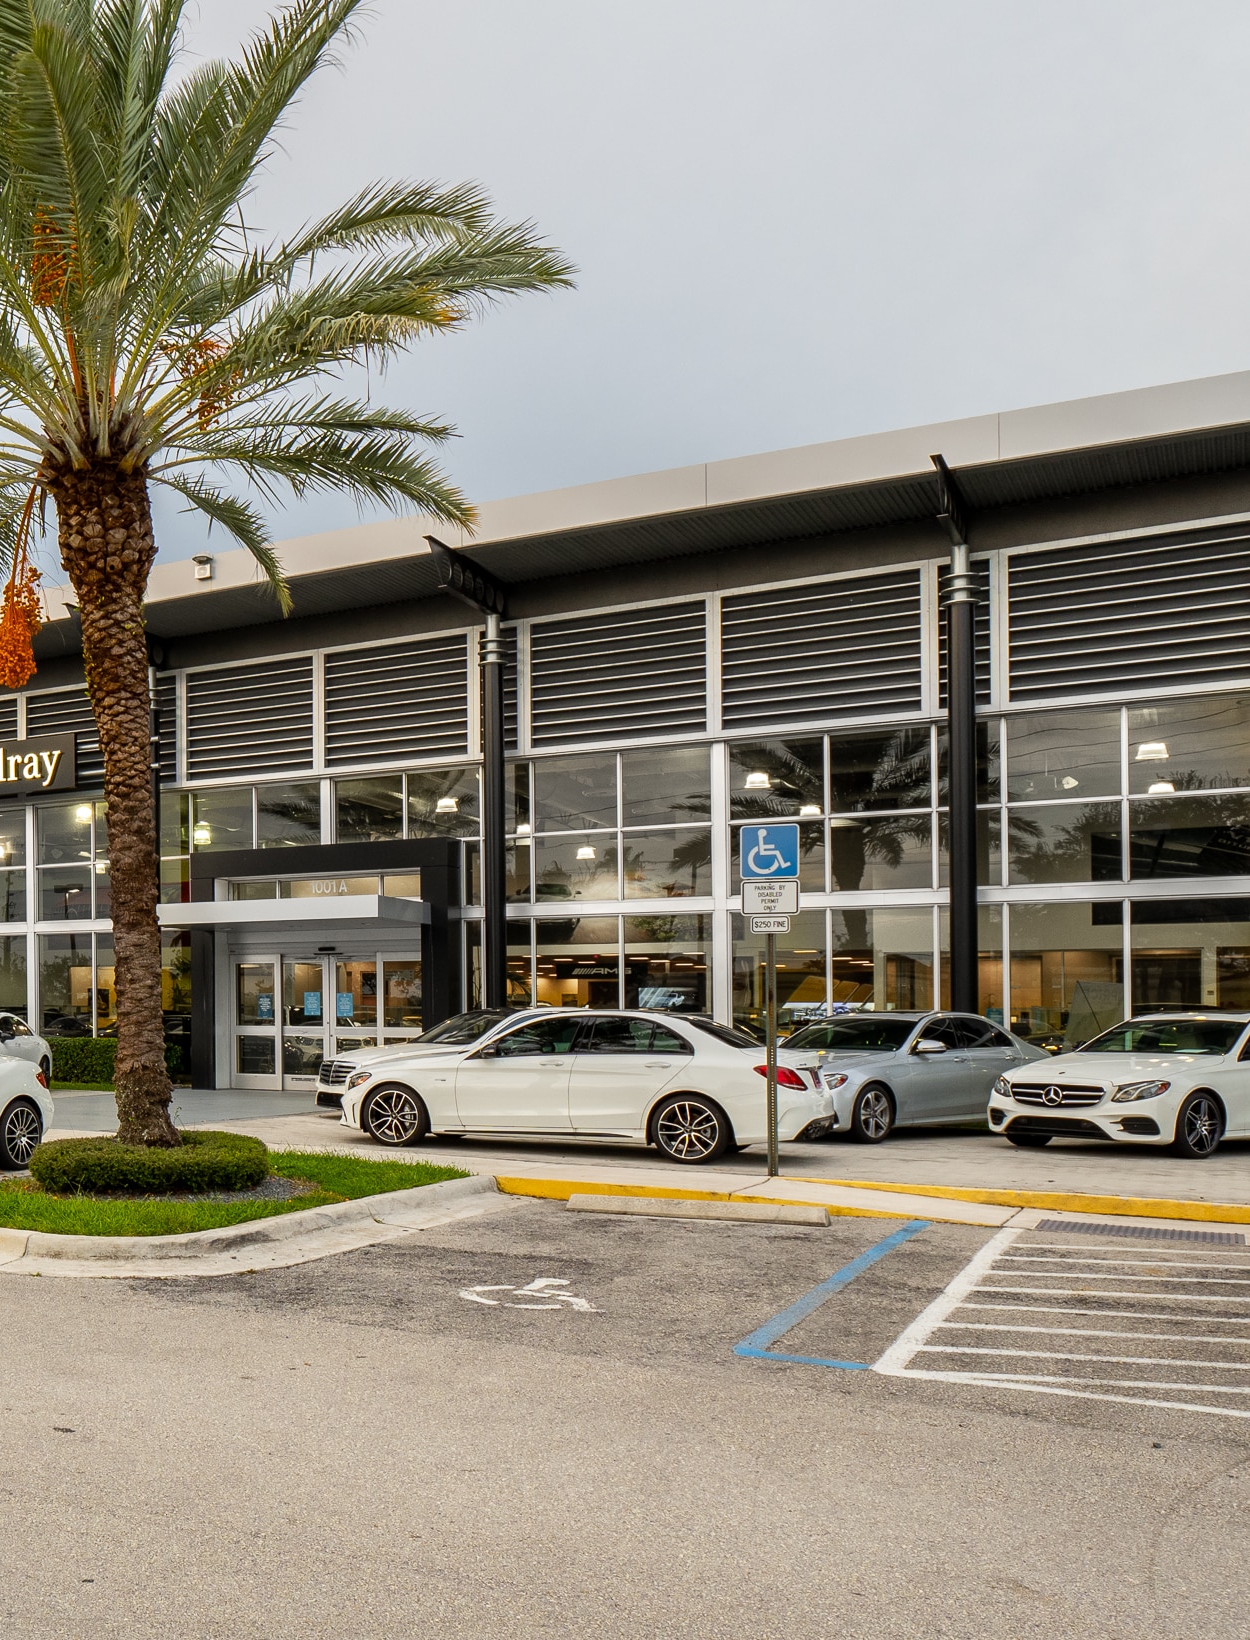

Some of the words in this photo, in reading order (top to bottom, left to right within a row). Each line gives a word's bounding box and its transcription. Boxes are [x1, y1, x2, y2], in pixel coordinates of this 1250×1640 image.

[310, 880, 337, 893] 1001
[338, 880, 348, 893] A
[754, 920, 771, 929] $250
